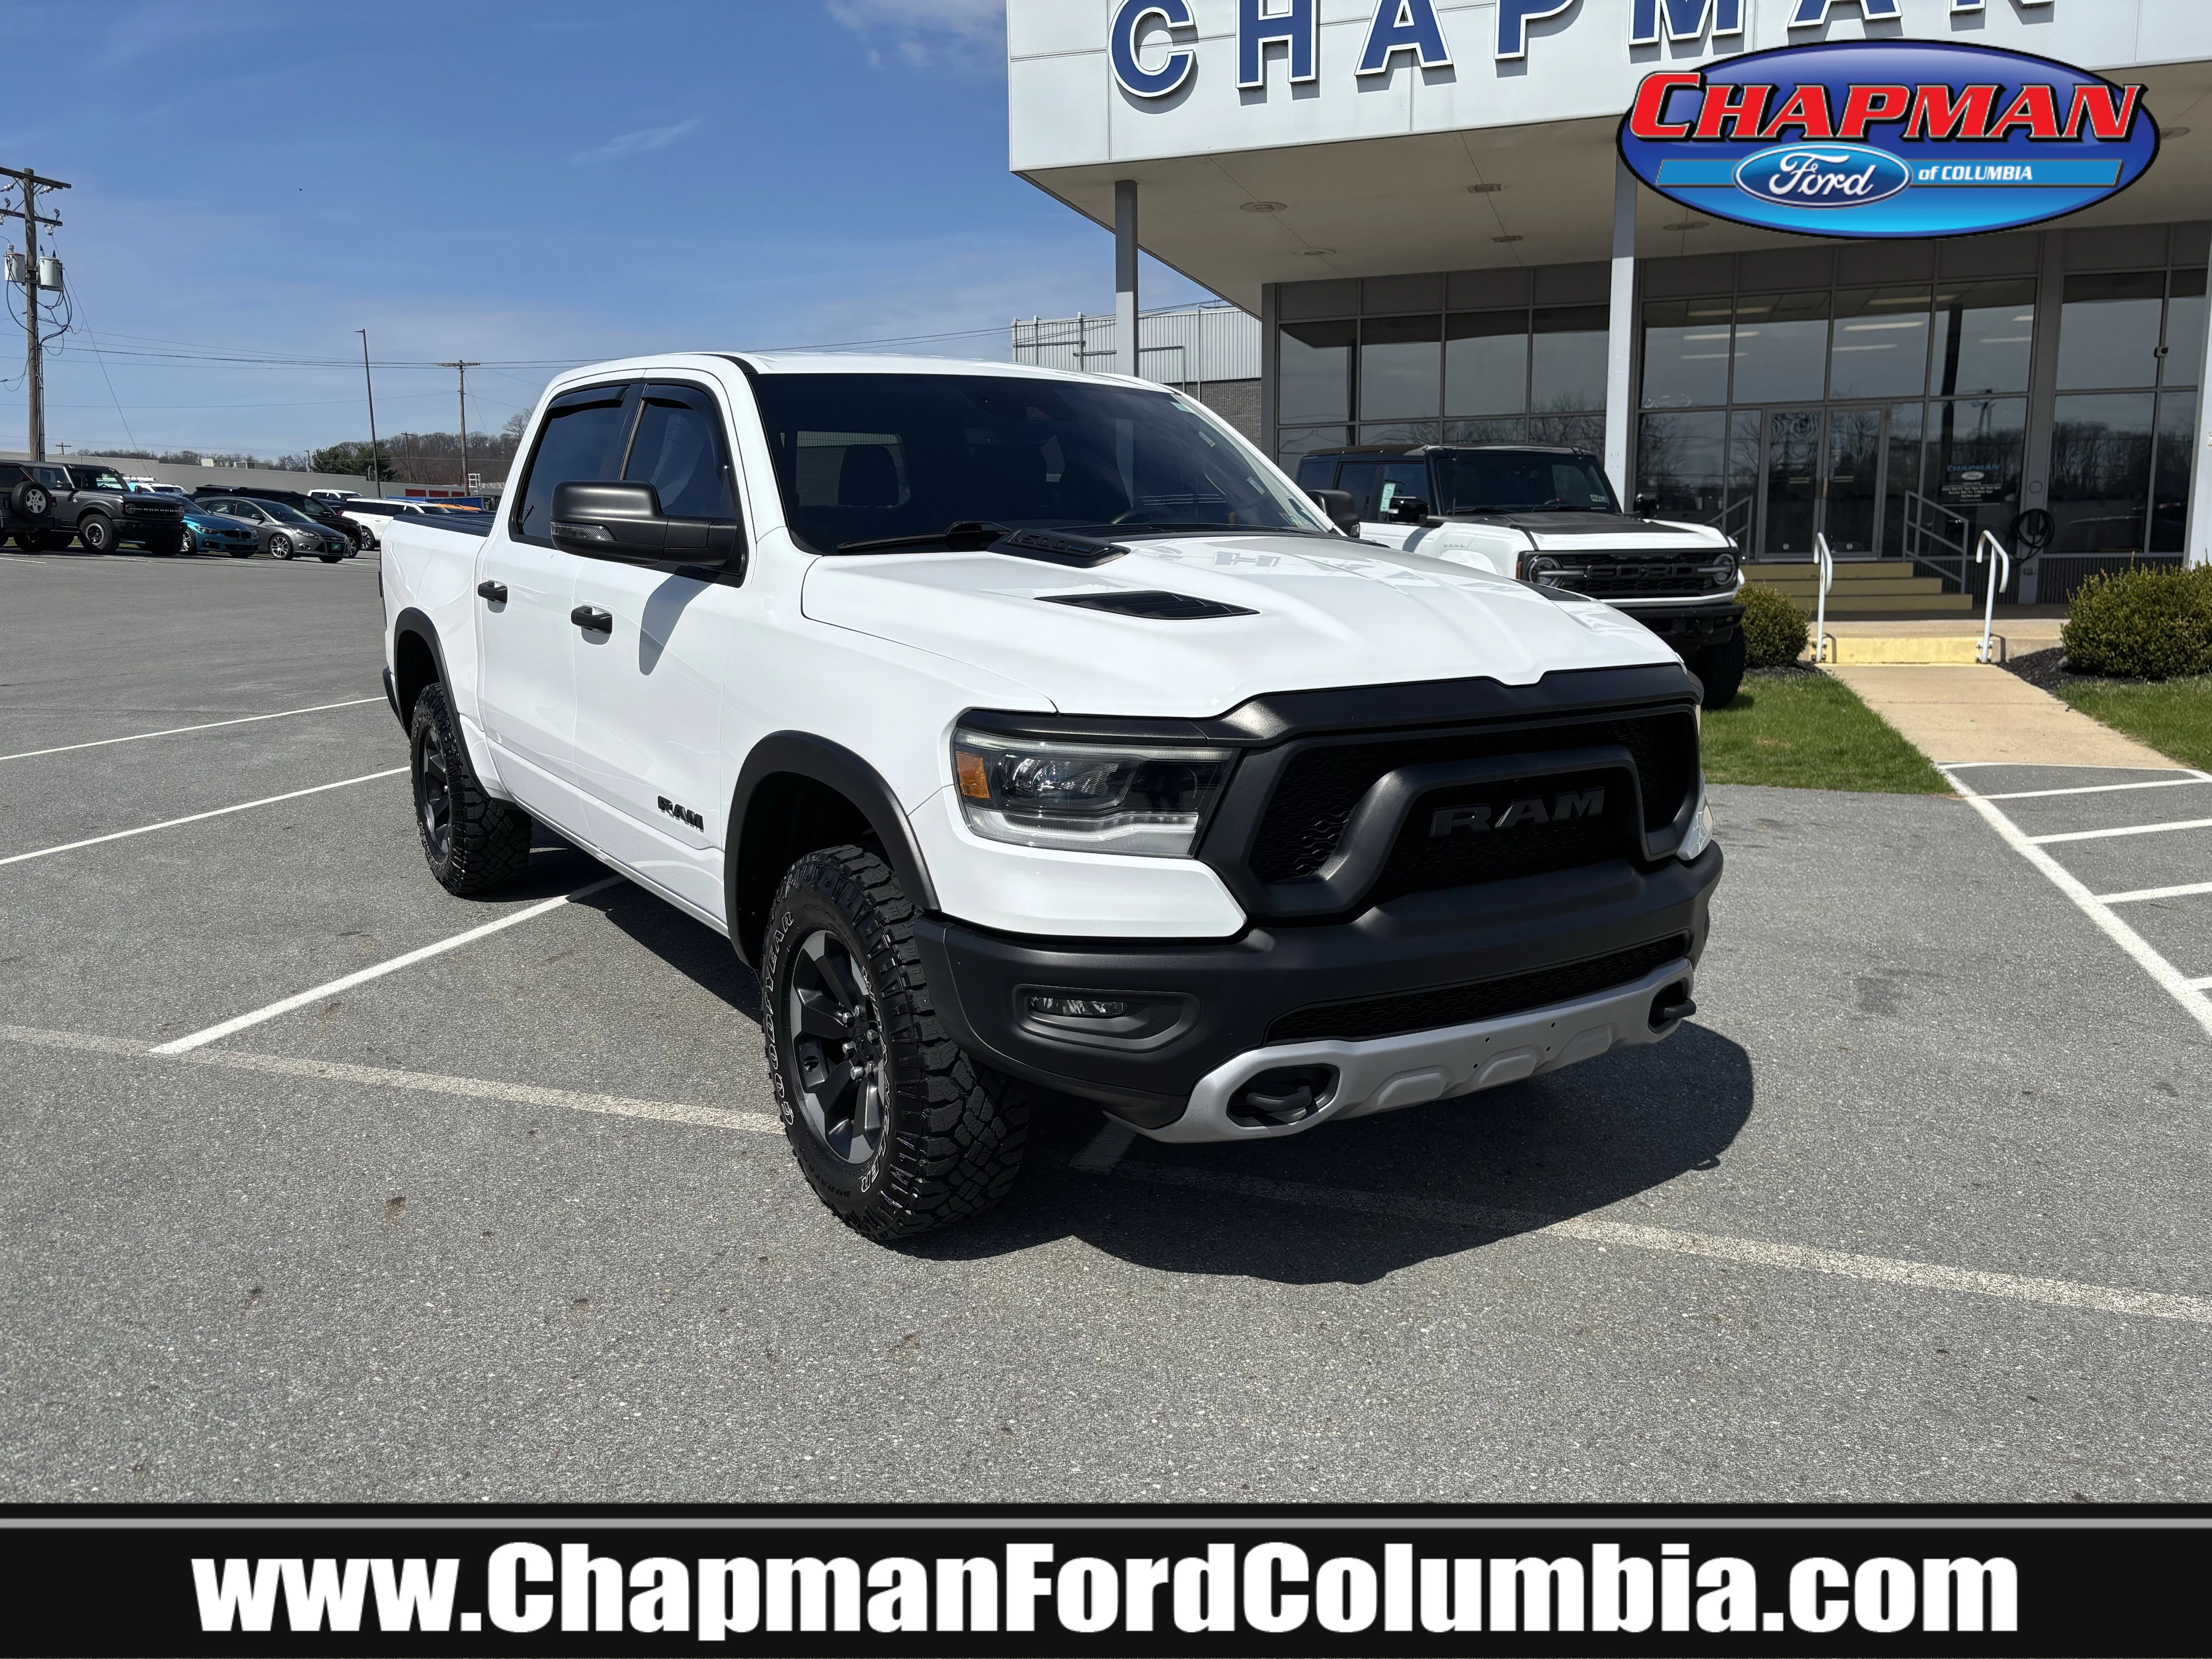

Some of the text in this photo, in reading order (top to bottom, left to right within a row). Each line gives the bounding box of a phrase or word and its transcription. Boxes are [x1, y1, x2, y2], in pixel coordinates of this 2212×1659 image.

[1109, 0, 2051, 97] CHAP
[658, 795, 704, 831] RAM
[1429, 787, 1605, 838] RAM
[764, 910, 795, 1126] GOODYEAR
